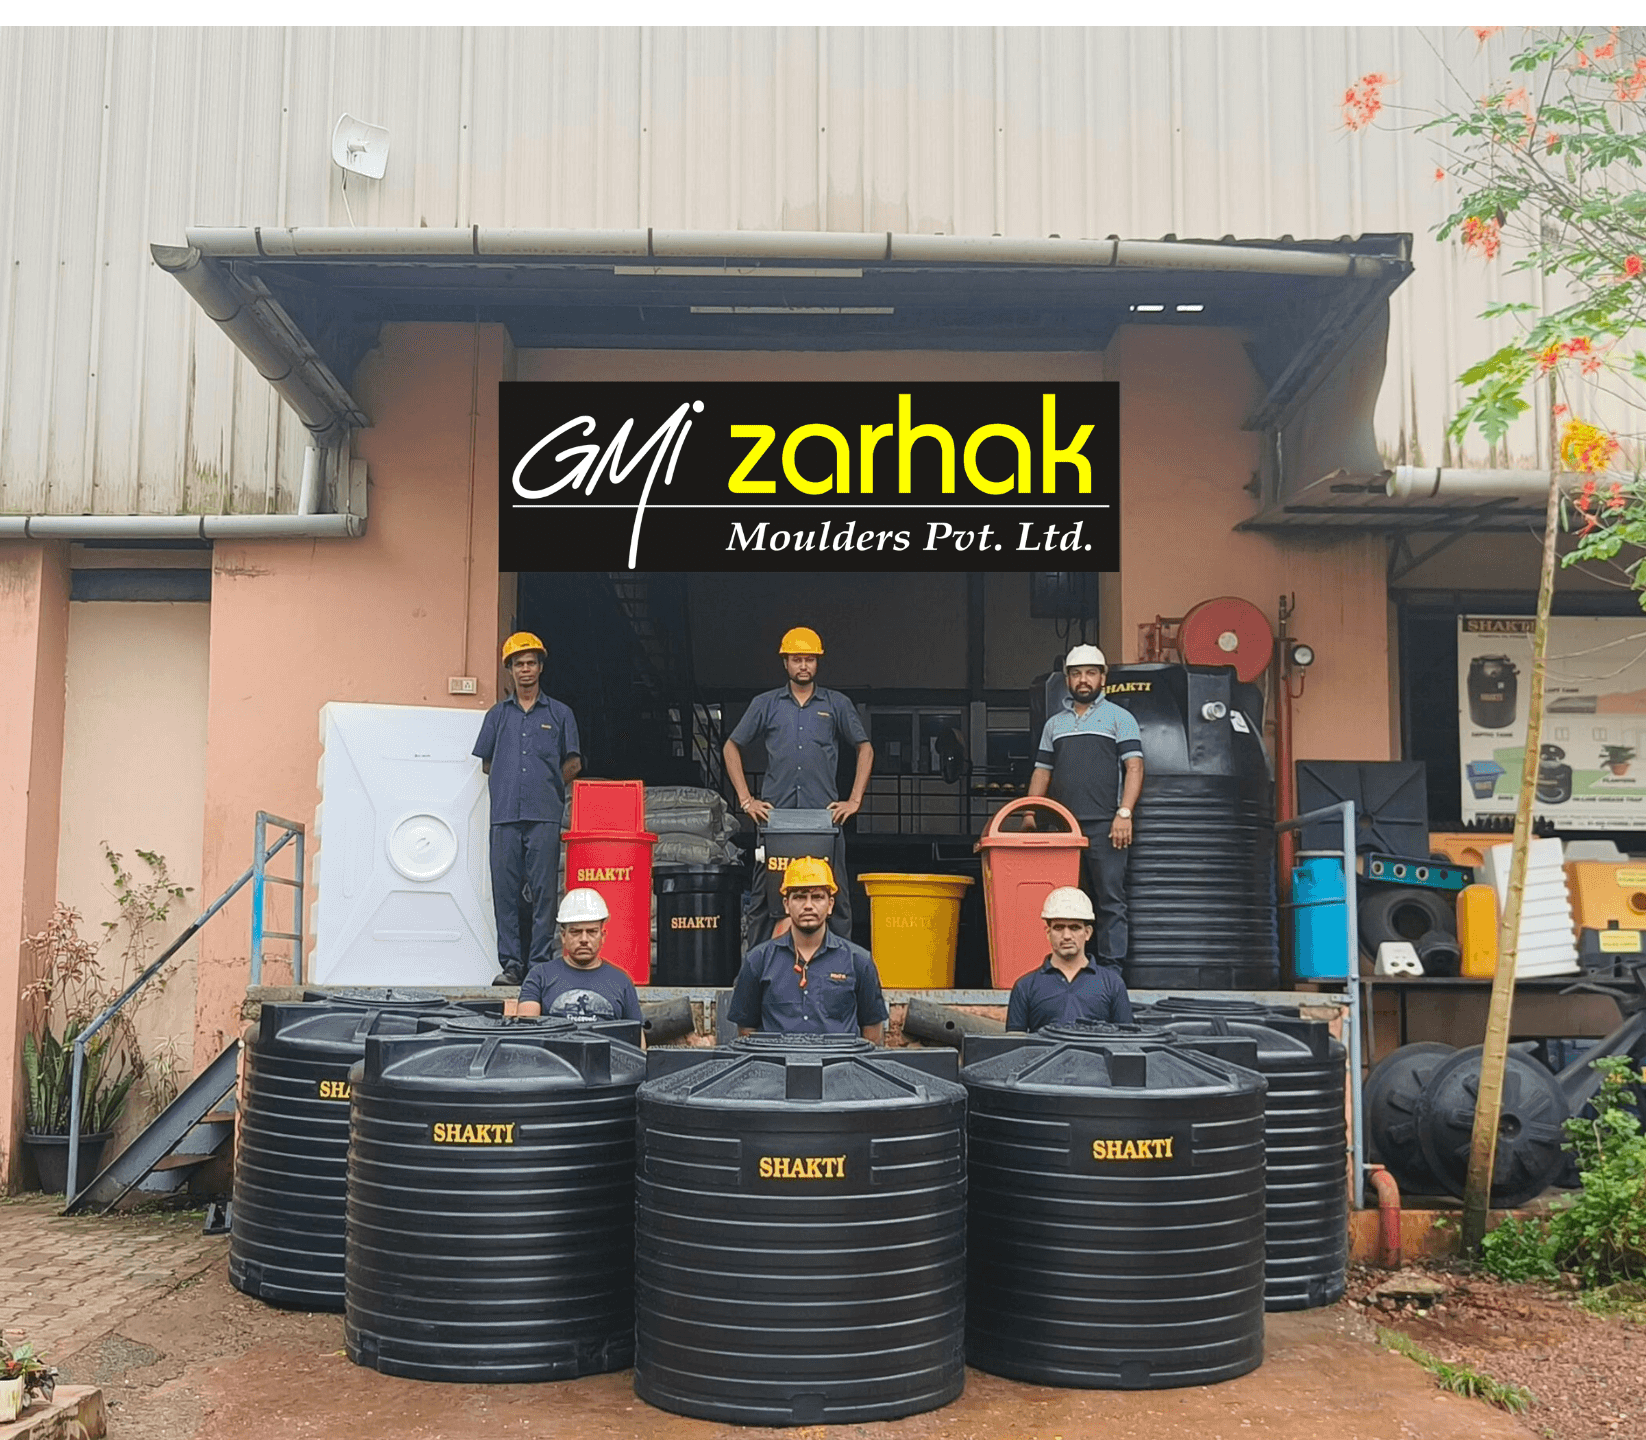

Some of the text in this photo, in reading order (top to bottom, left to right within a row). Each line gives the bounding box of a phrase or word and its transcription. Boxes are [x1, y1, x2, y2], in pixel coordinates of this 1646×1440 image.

[728, 394, 1096, 495] zarhak
[726, 520, 1093, 552] Moulders Pvt. Ltd.
[1467, 619, 1535, 632] SHAKTI
[577, 867, 631, 882] SHAKTI
[671, 916, 719, 929] SHAKTI
[433, 1122, 515, 1144] SHAKTI
[1092, 1138, 1174, 1160] SHAKTI
[759, 1156, 846, 1179] SHAKTI
